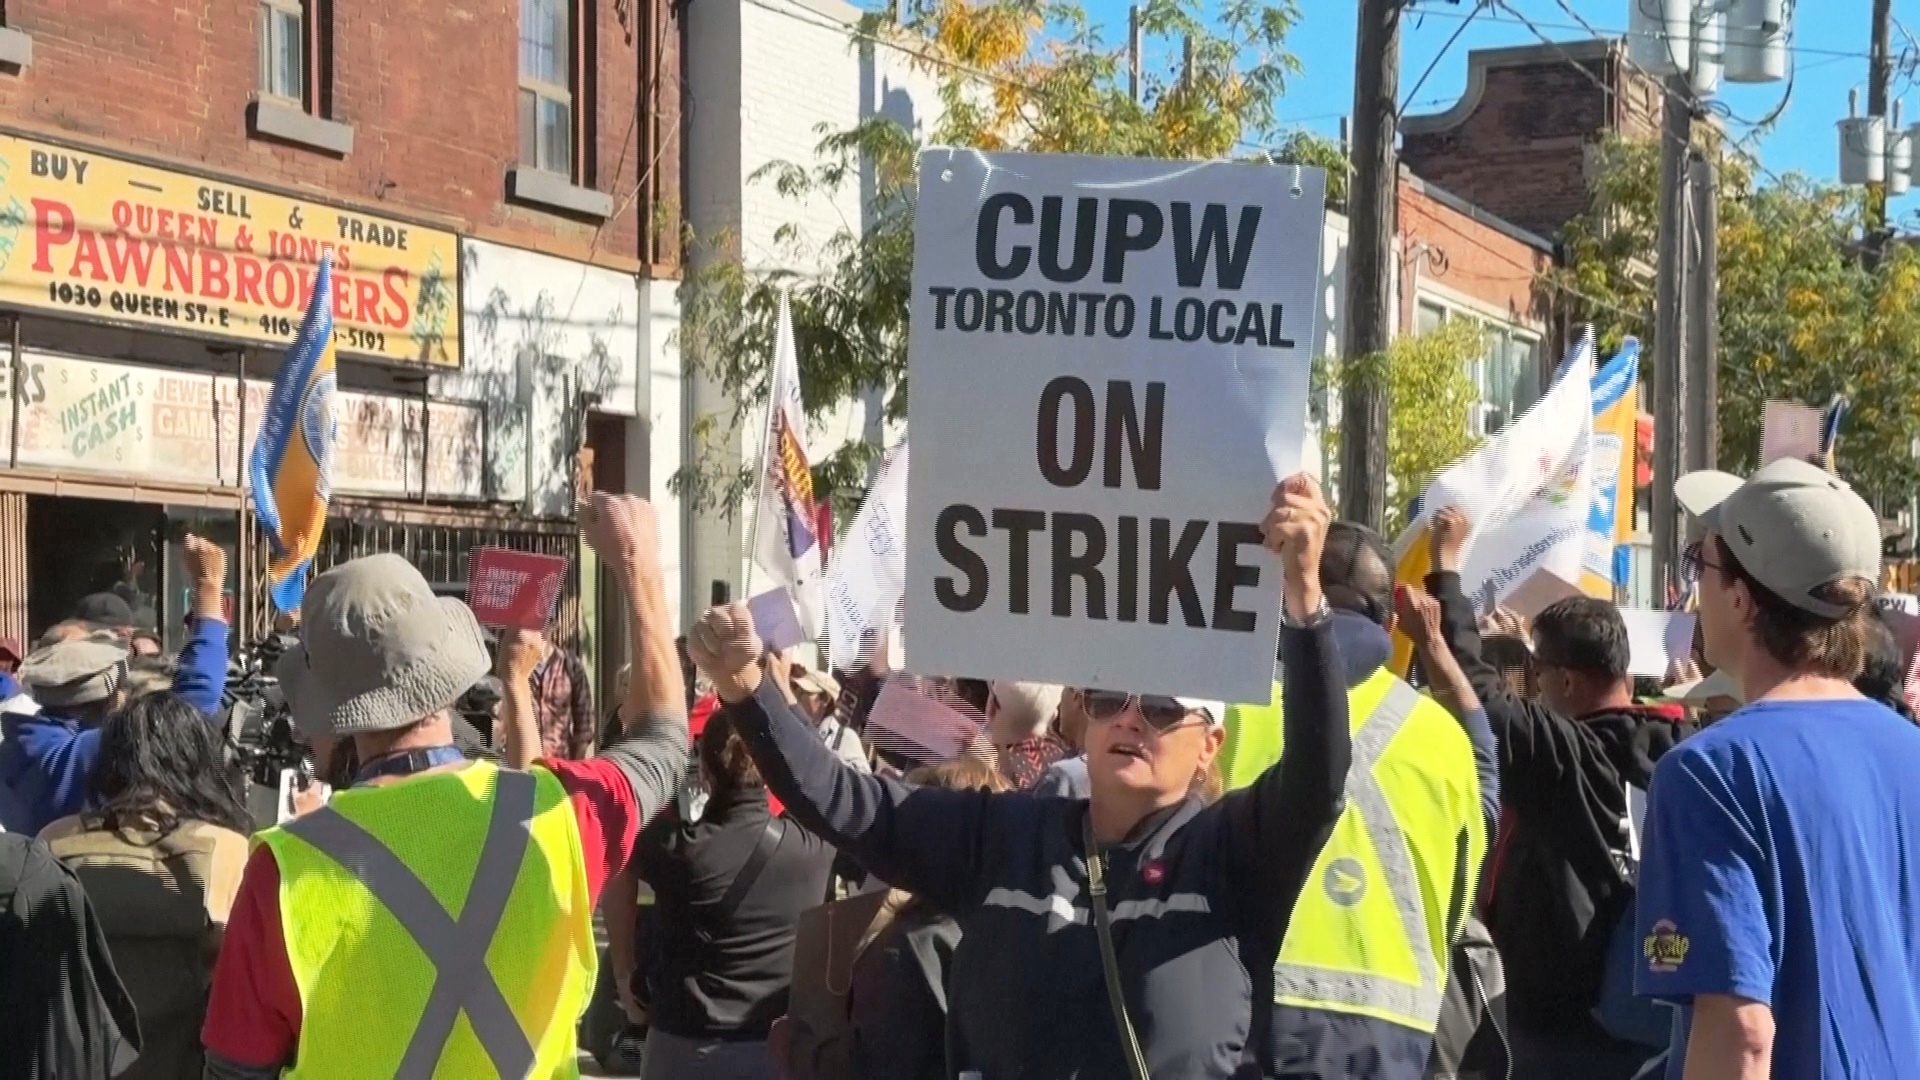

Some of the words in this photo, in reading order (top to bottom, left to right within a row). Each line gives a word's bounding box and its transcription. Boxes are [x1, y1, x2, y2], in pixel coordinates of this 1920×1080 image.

[31, 150, 89, 185] BUY
[197, 187, 251, 220] SELL
[288, 206, 304, 230] &
[338, 217, 408, 251] TRADE
[112, 199, 218, 248] QUEEN
[235, 224, 254, 253] &
[975, 192, 1262, 290] CUPW
[49, 281, 101, 308] 1030
[110, 288, 178, 320] QUEEN
[184, 305, 214, 326] ST.
[218, 308, 230, 328] E
[929, 286, 1136, 338] TORONTO
[1149, 295, 1295, 348] LOCAL
[61, 372, 130, 435] INSTANT
[72, 400, 136, 459] CASH
[1036, 375, 1166, 491] ON
[934, 503, 1267, 632] STRIKE
